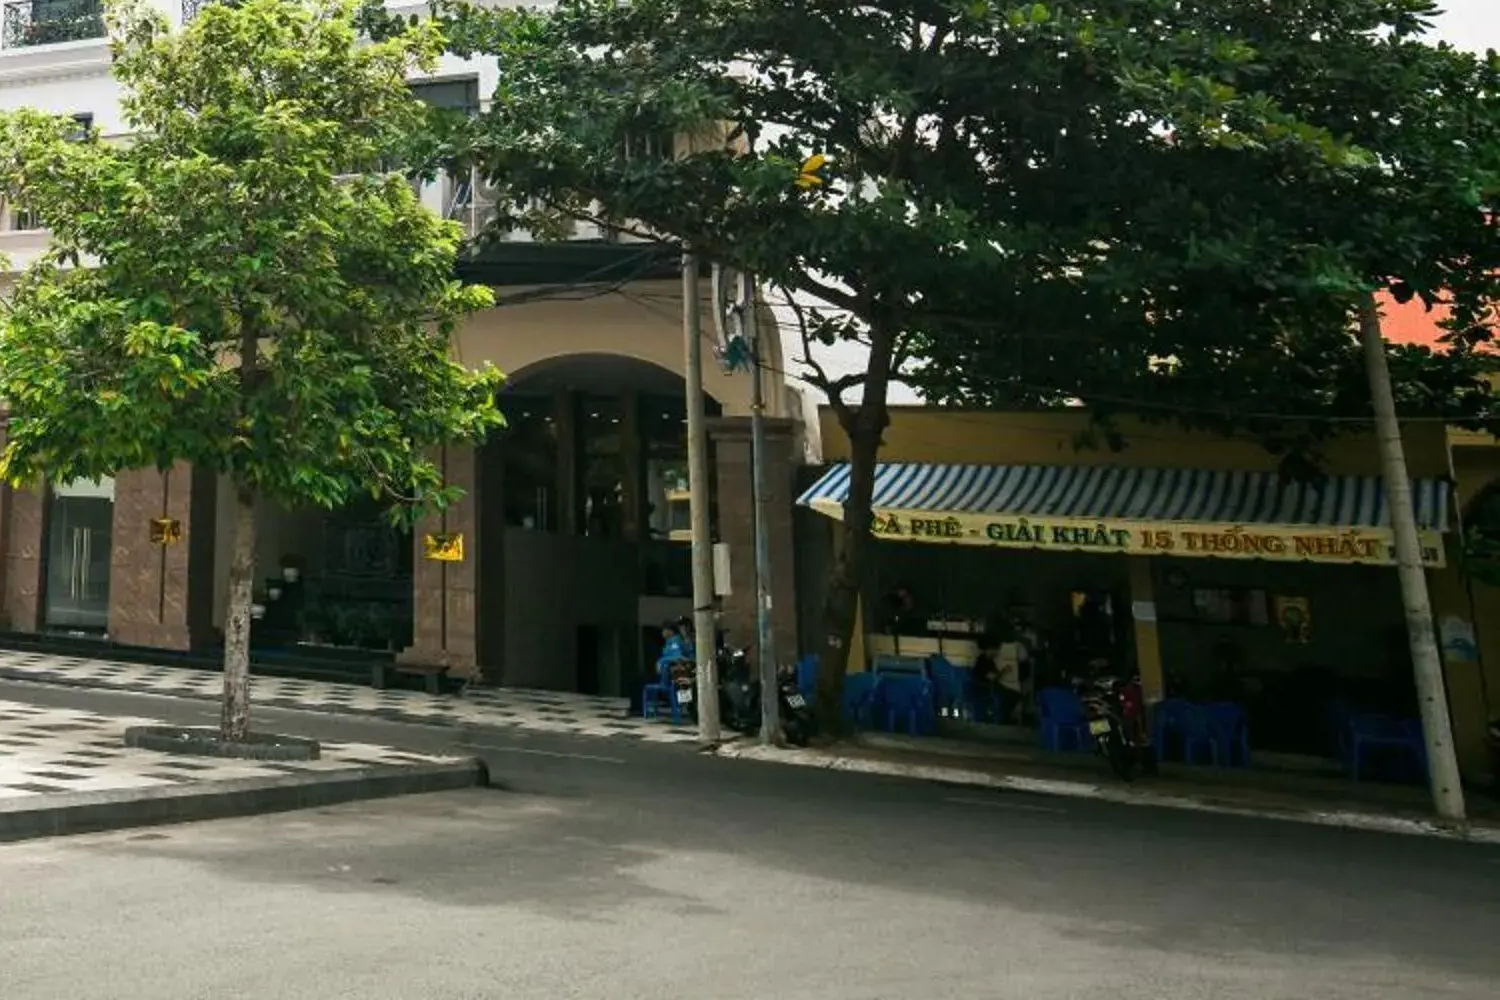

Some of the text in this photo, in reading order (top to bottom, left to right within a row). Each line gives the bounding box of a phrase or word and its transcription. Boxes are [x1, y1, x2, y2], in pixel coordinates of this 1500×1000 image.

[910, 516, 963, 538] PHÊ
[1140, 529, 1175, 549] 15
[1181, 524, 1285, 555] THỐNG
